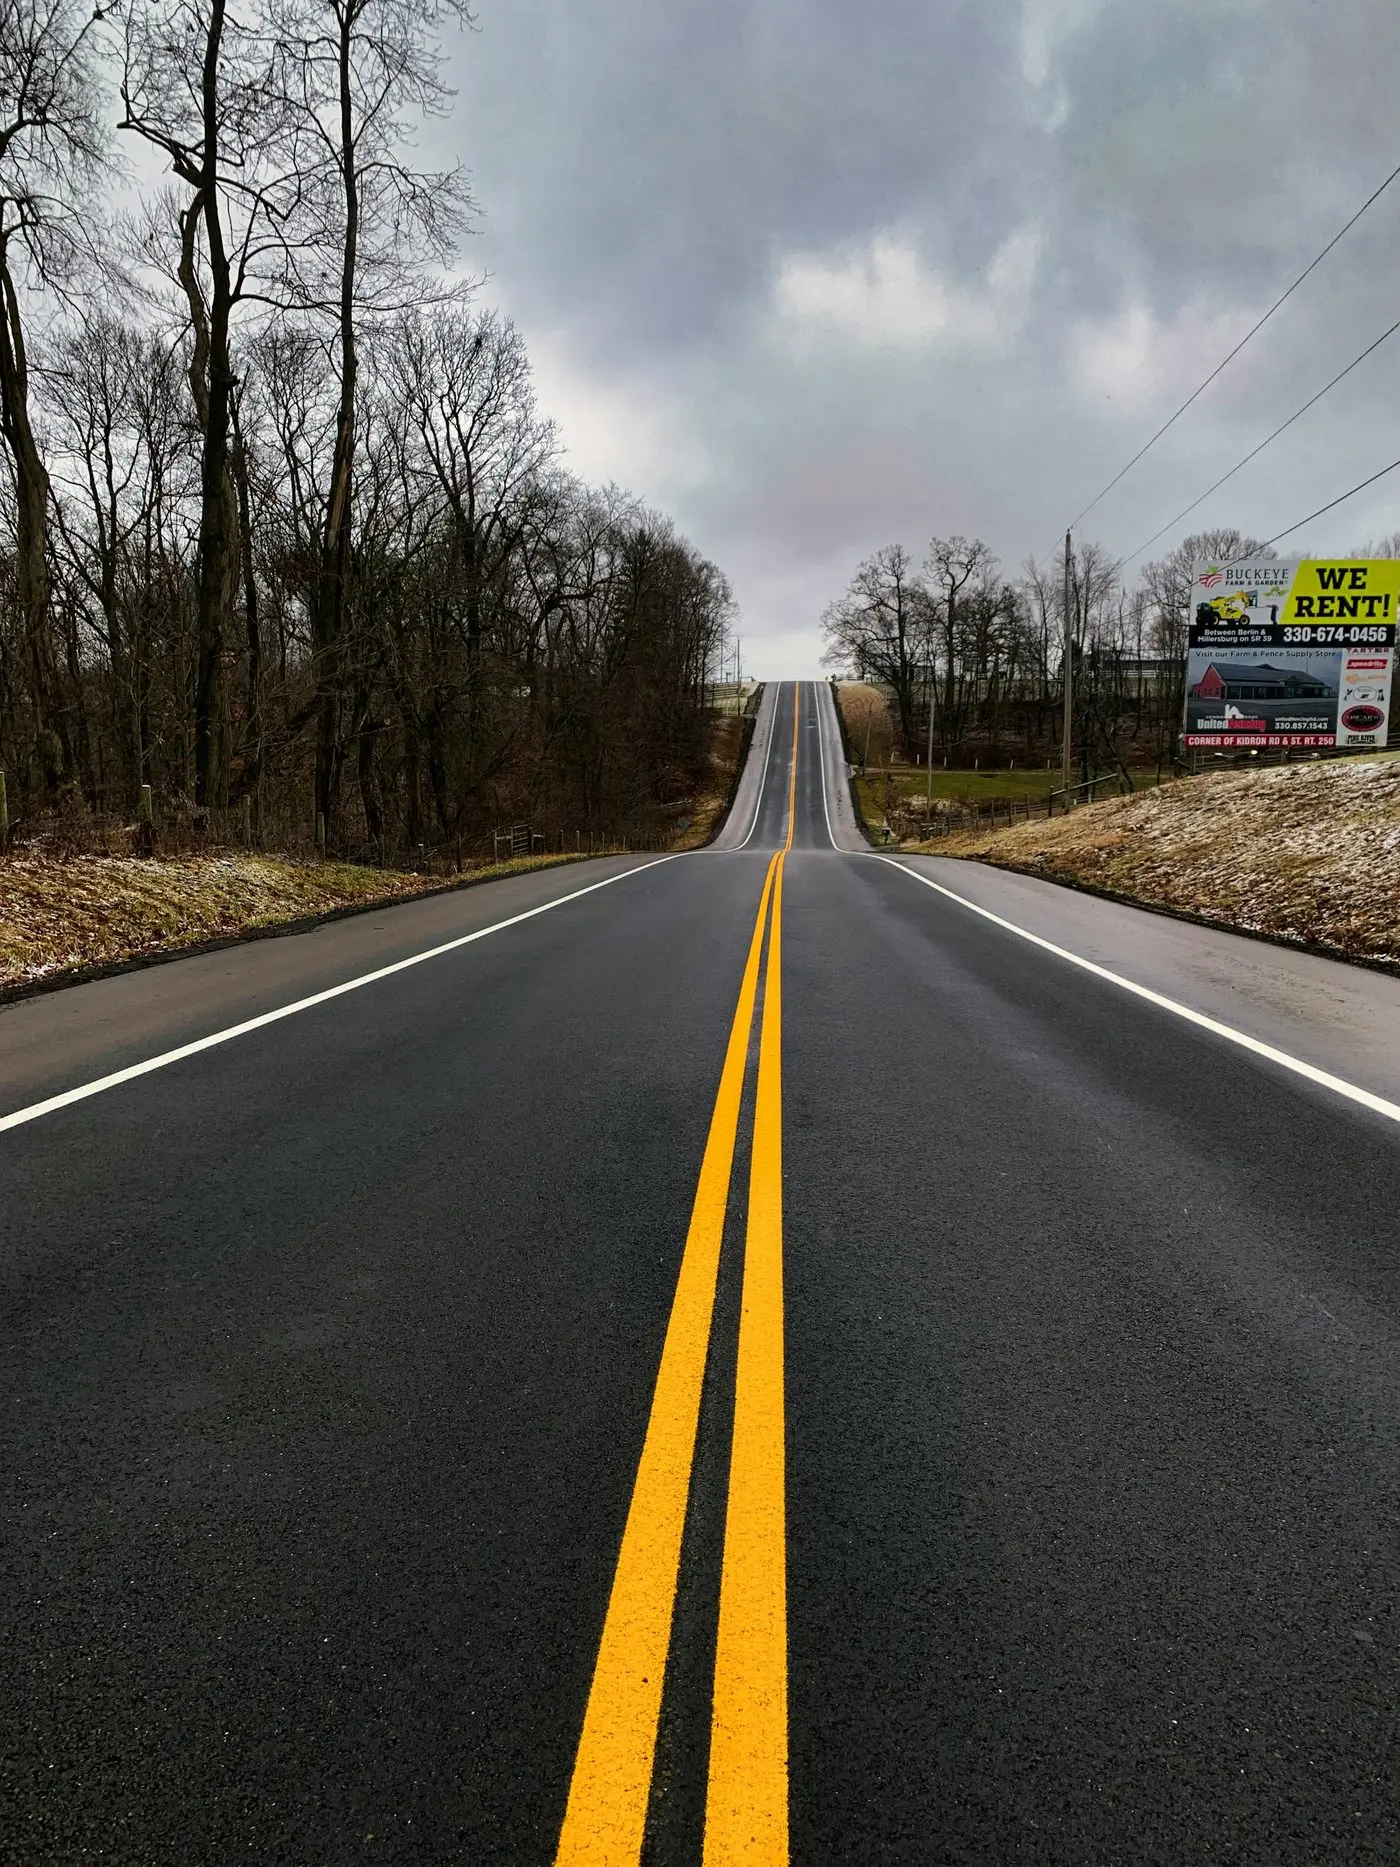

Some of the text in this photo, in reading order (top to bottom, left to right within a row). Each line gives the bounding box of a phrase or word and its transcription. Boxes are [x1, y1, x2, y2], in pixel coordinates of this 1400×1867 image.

[1226, 568, 1289, 580] BUCKEYE
[1316, 568, 1368, 590] WE
[1294, 594, 1390, 618] RENT!
[1283, 626, 1388, 642] 330-674-0456
[1274, 722, 1328, 730] 330.857.1543
[1188, 736, 1334, 746] CORNER OF KIDRON RD & ST. RT. 250
